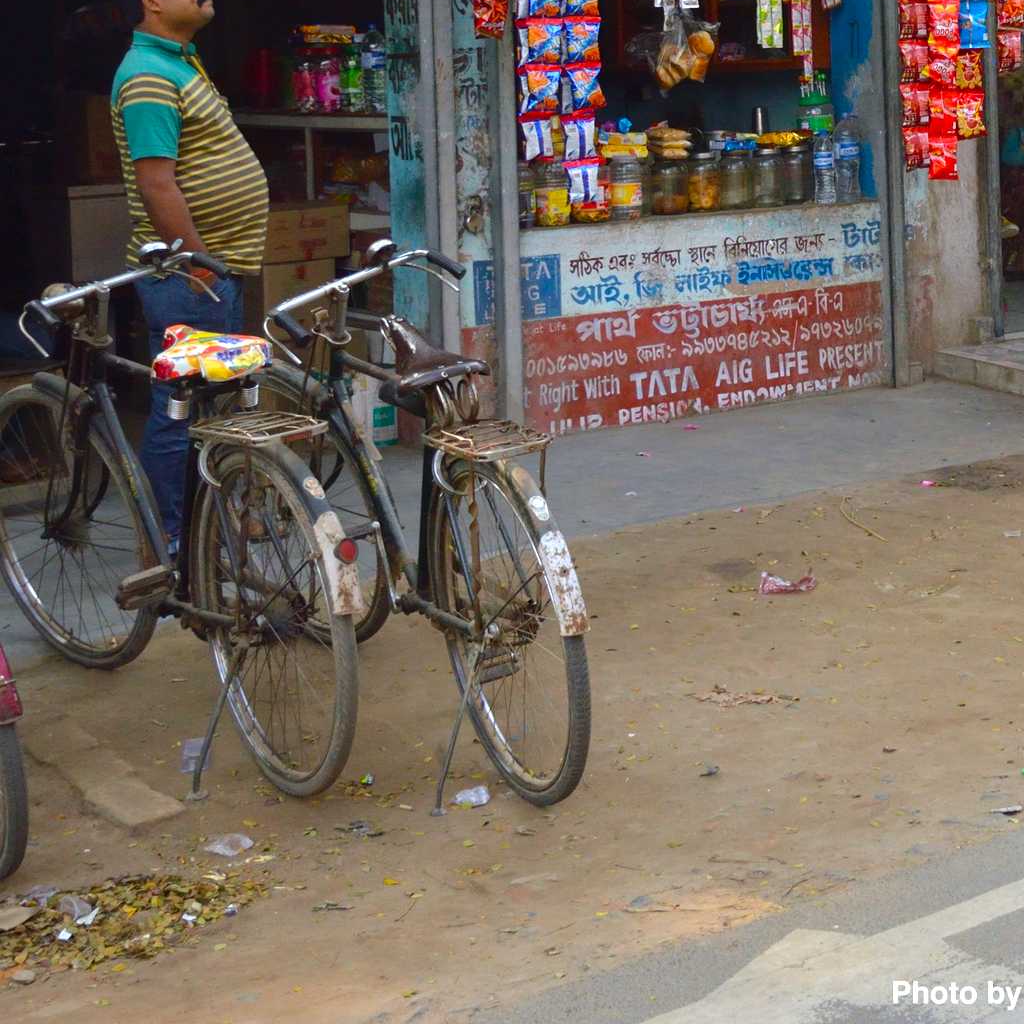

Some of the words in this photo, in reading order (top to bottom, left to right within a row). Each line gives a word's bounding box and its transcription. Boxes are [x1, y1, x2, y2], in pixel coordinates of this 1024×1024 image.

[570, 251, 604, 279] সঠিক
[673, 266, 732, 294] লাইফ
[575, 309, 640, 343] পার্থ
[539, 378, 580, 413] Right
[583, 373, 621, 400] With
[630, 365, 700, 401] TATA
[715, 358, 753, 388] AIG
[765, 350, 809, 380] LIFE
